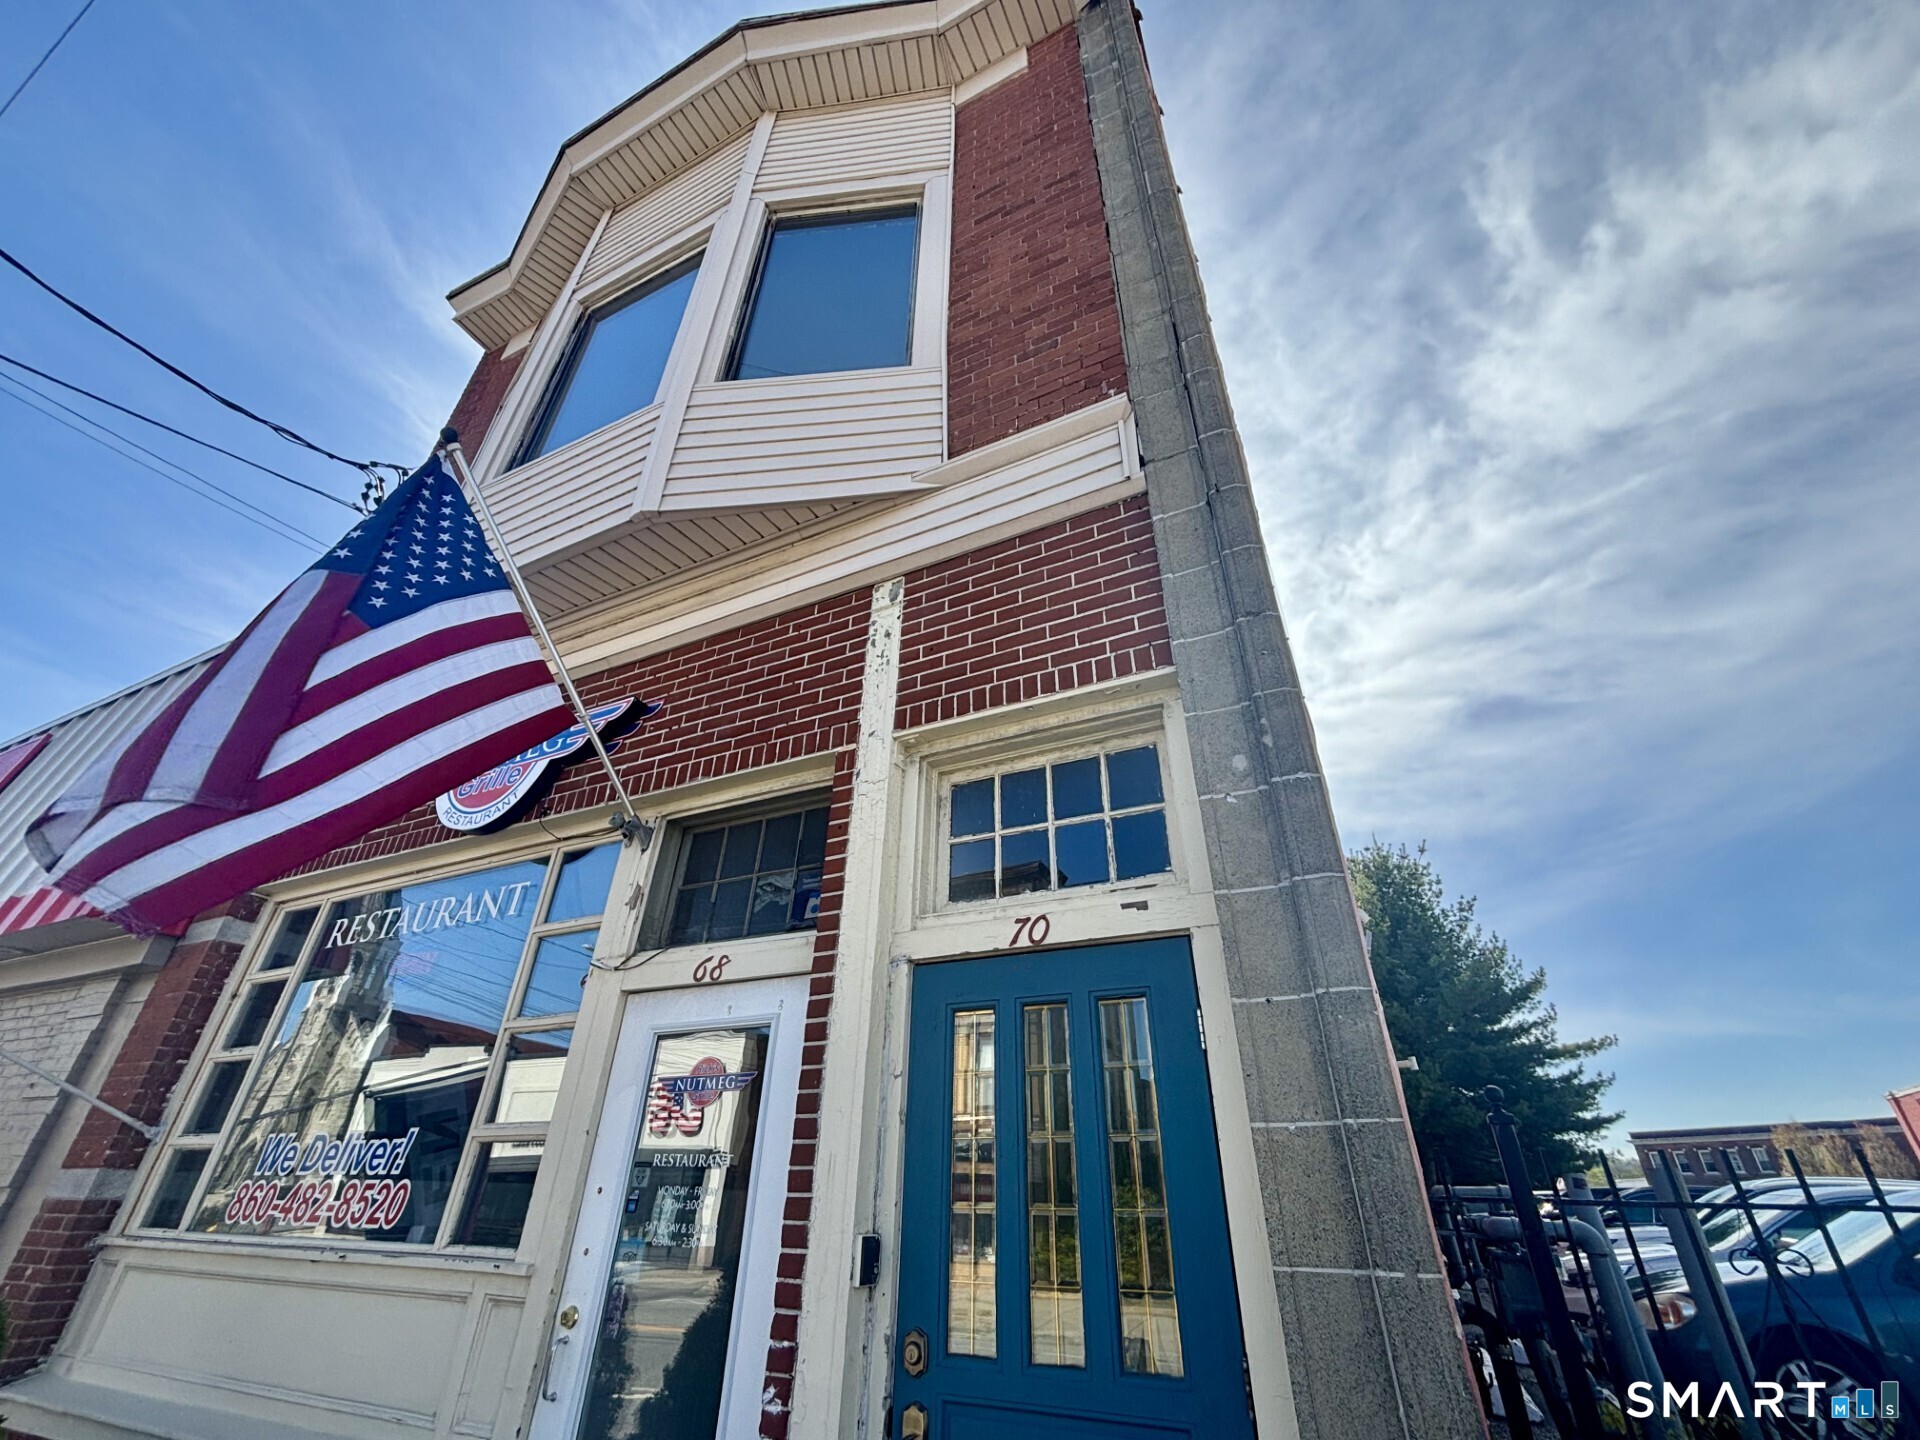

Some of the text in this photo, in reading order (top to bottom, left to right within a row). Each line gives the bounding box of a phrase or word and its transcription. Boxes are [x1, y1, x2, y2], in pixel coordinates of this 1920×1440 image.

[457, 763, 522, 799] Grille
[443, 792, 521, 826] RESTAURANT
[325, 881, 531, 949] RESTAURANT
[1009, 914, 1050, 947] 70
[693, 954, 731, 982] 68
[675, 1075, 736, 1092] NUTMEG
[254, 1132, 301, 1176] We
[296, 1127, 420, 1176] Deliver!
[653, 1153, 733, 1168] RESTAURANT
[225, 1178, 411, 1230] 860-482-8520
[658, 1185, 690, 1196] MONDAY
[644, 1221, 681, 1234] SATURDAY
[688, 1223, 718, 1235] SUNY
